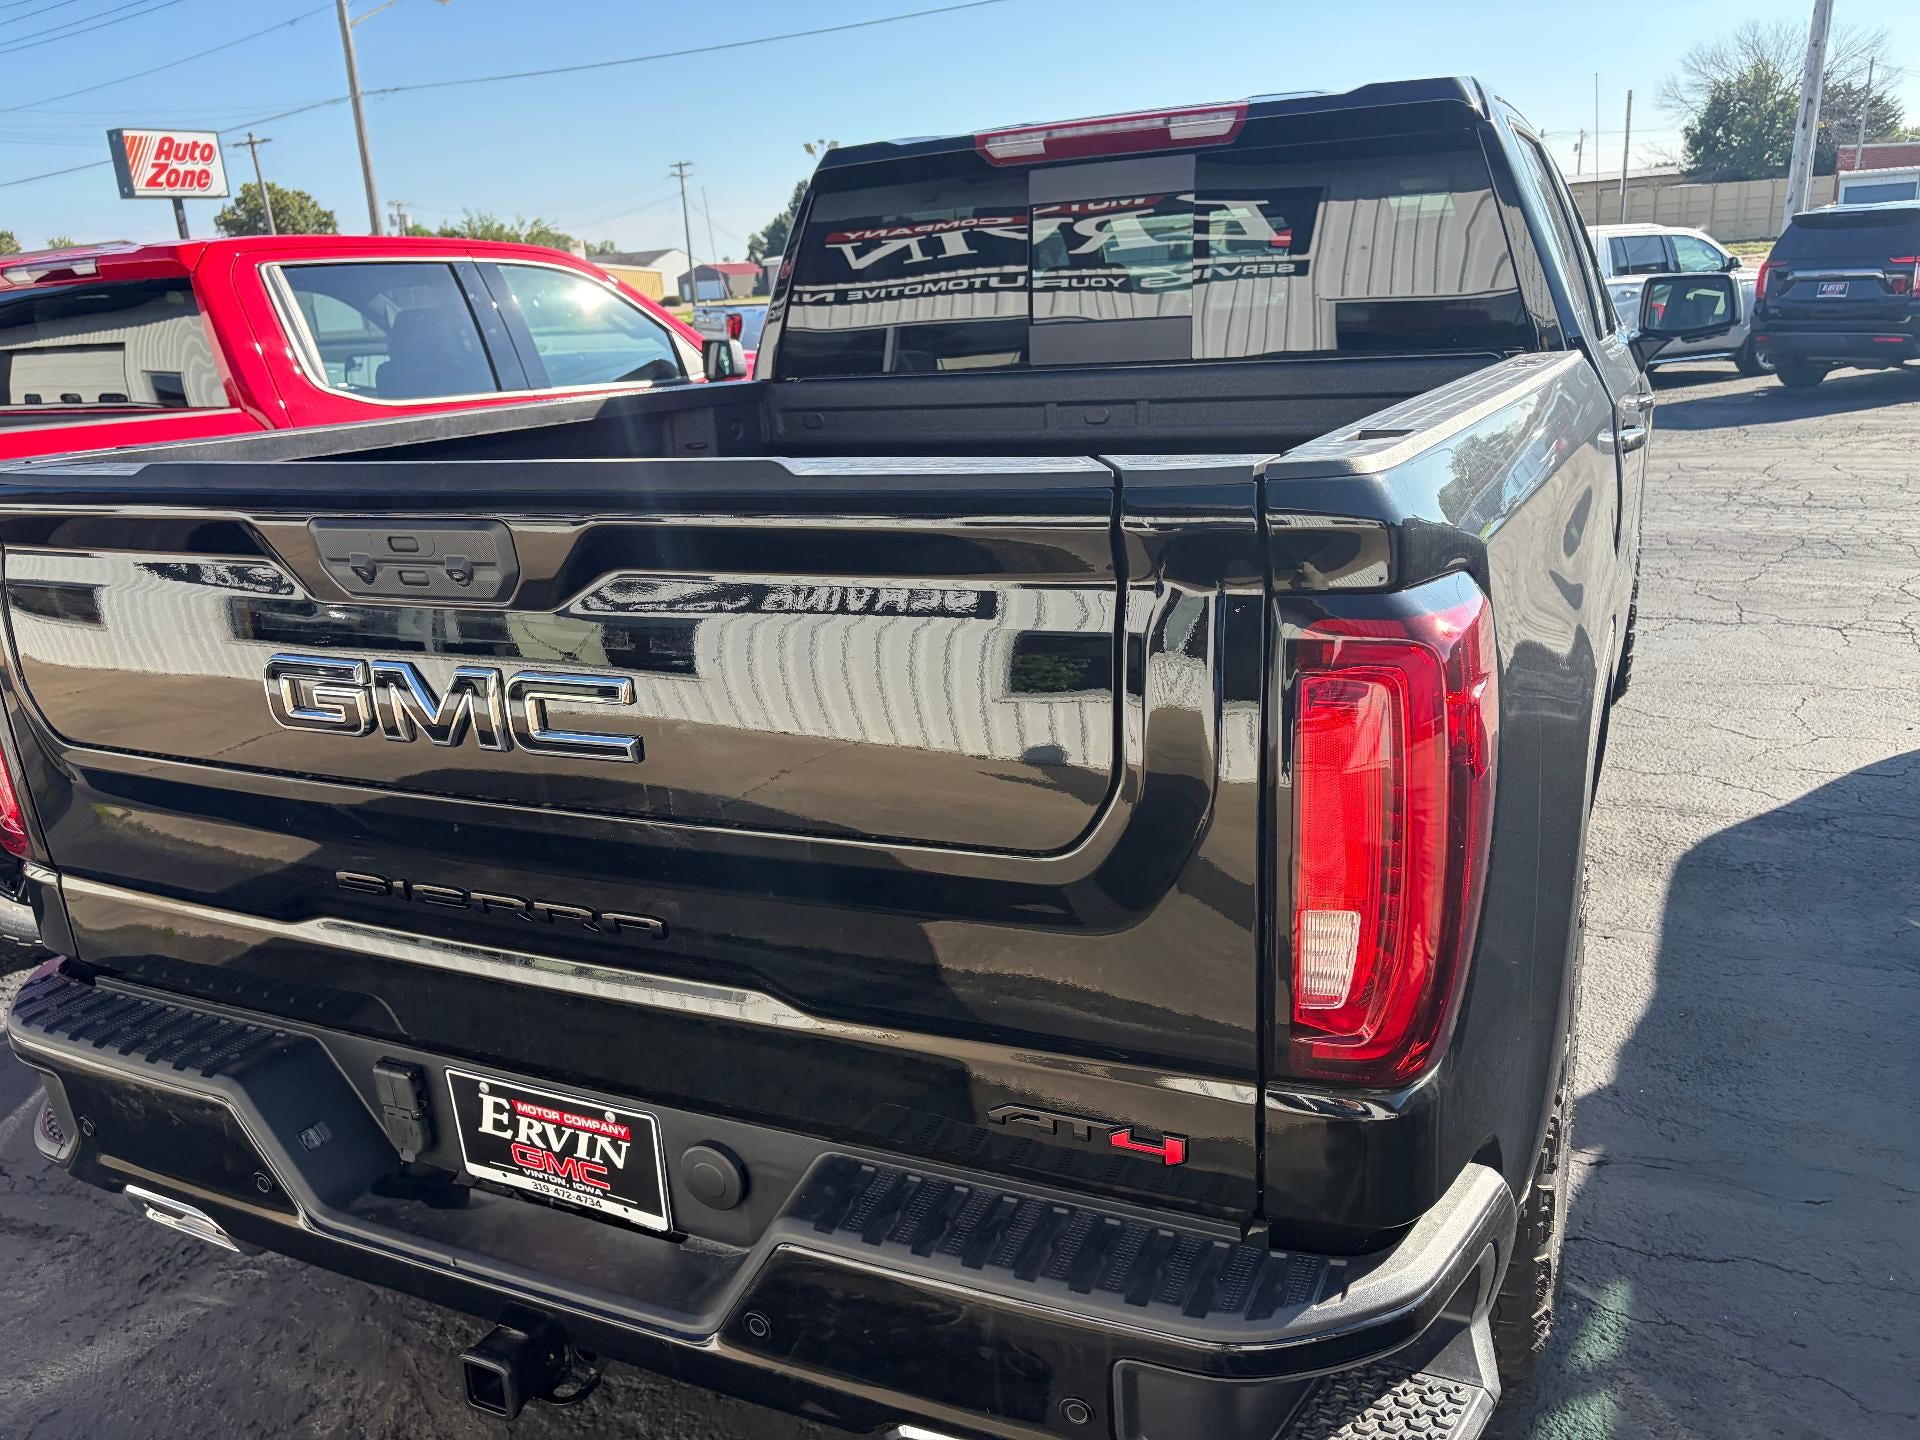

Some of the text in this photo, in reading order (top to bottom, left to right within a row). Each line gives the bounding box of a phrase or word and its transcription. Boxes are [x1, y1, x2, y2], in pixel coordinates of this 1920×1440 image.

[154, 136, 214, 162] Auto
[145, 162, 210, 189] Zone
[264, 652, 645, 763] GMC
[336, 870, 669, 939] SIERRA
[478, 1092, 631, 1169] ERVIN
[517, 1103, 628, 1136] MOTOR COMPANY
[988, 1103, 1189, 1166] AT4
[511, 1143, 610, 1190] GMC
[522, 1168, 604, 1197] VINTON, IOWA
[531, 1181, 602, 1209] 319-472-4734
